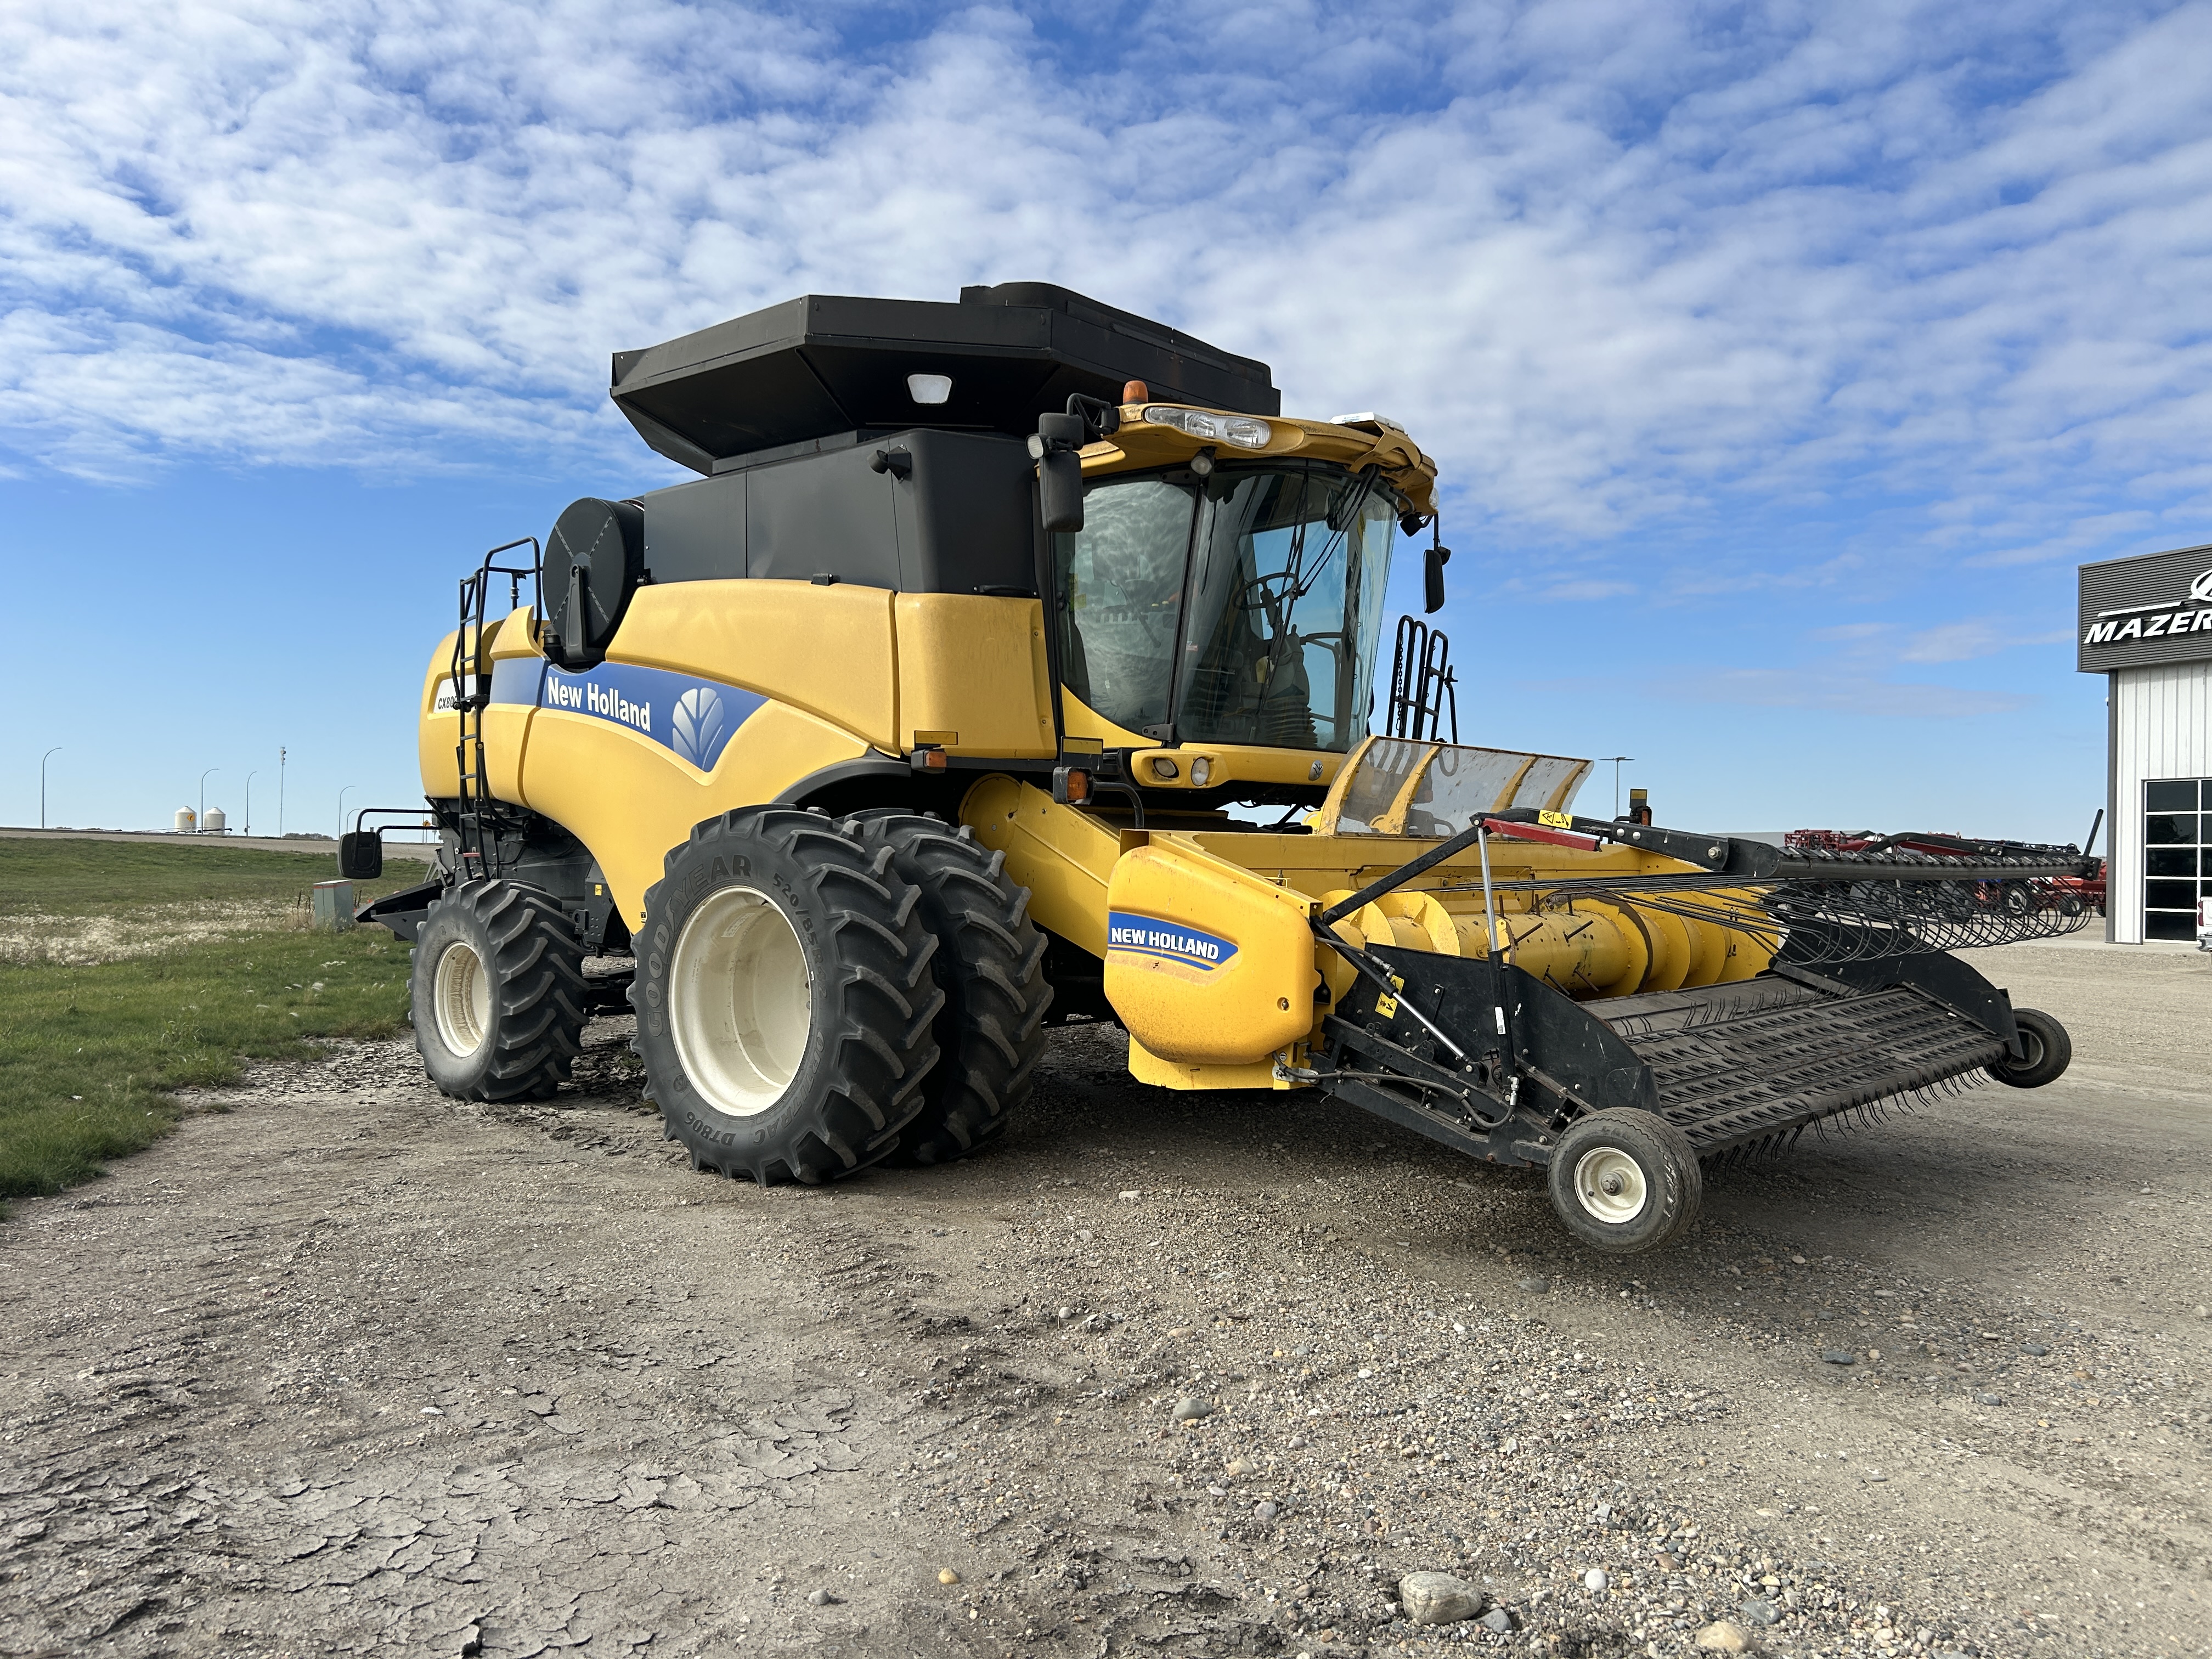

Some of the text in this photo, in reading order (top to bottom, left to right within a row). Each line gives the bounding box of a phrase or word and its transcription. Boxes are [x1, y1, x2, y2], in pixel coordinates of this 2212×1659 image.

[2084, 609, 2212, 644] MAZER
[548, 676, 651, 732] New Holland
[645, 854, 752, 1037] GOODYEAR
[1111, 927, 1219, 960] NEW HOLLAND
[753, 1030, 825, 1146] OPTITRAC
[684, 1111, 737, 1147] DT806
